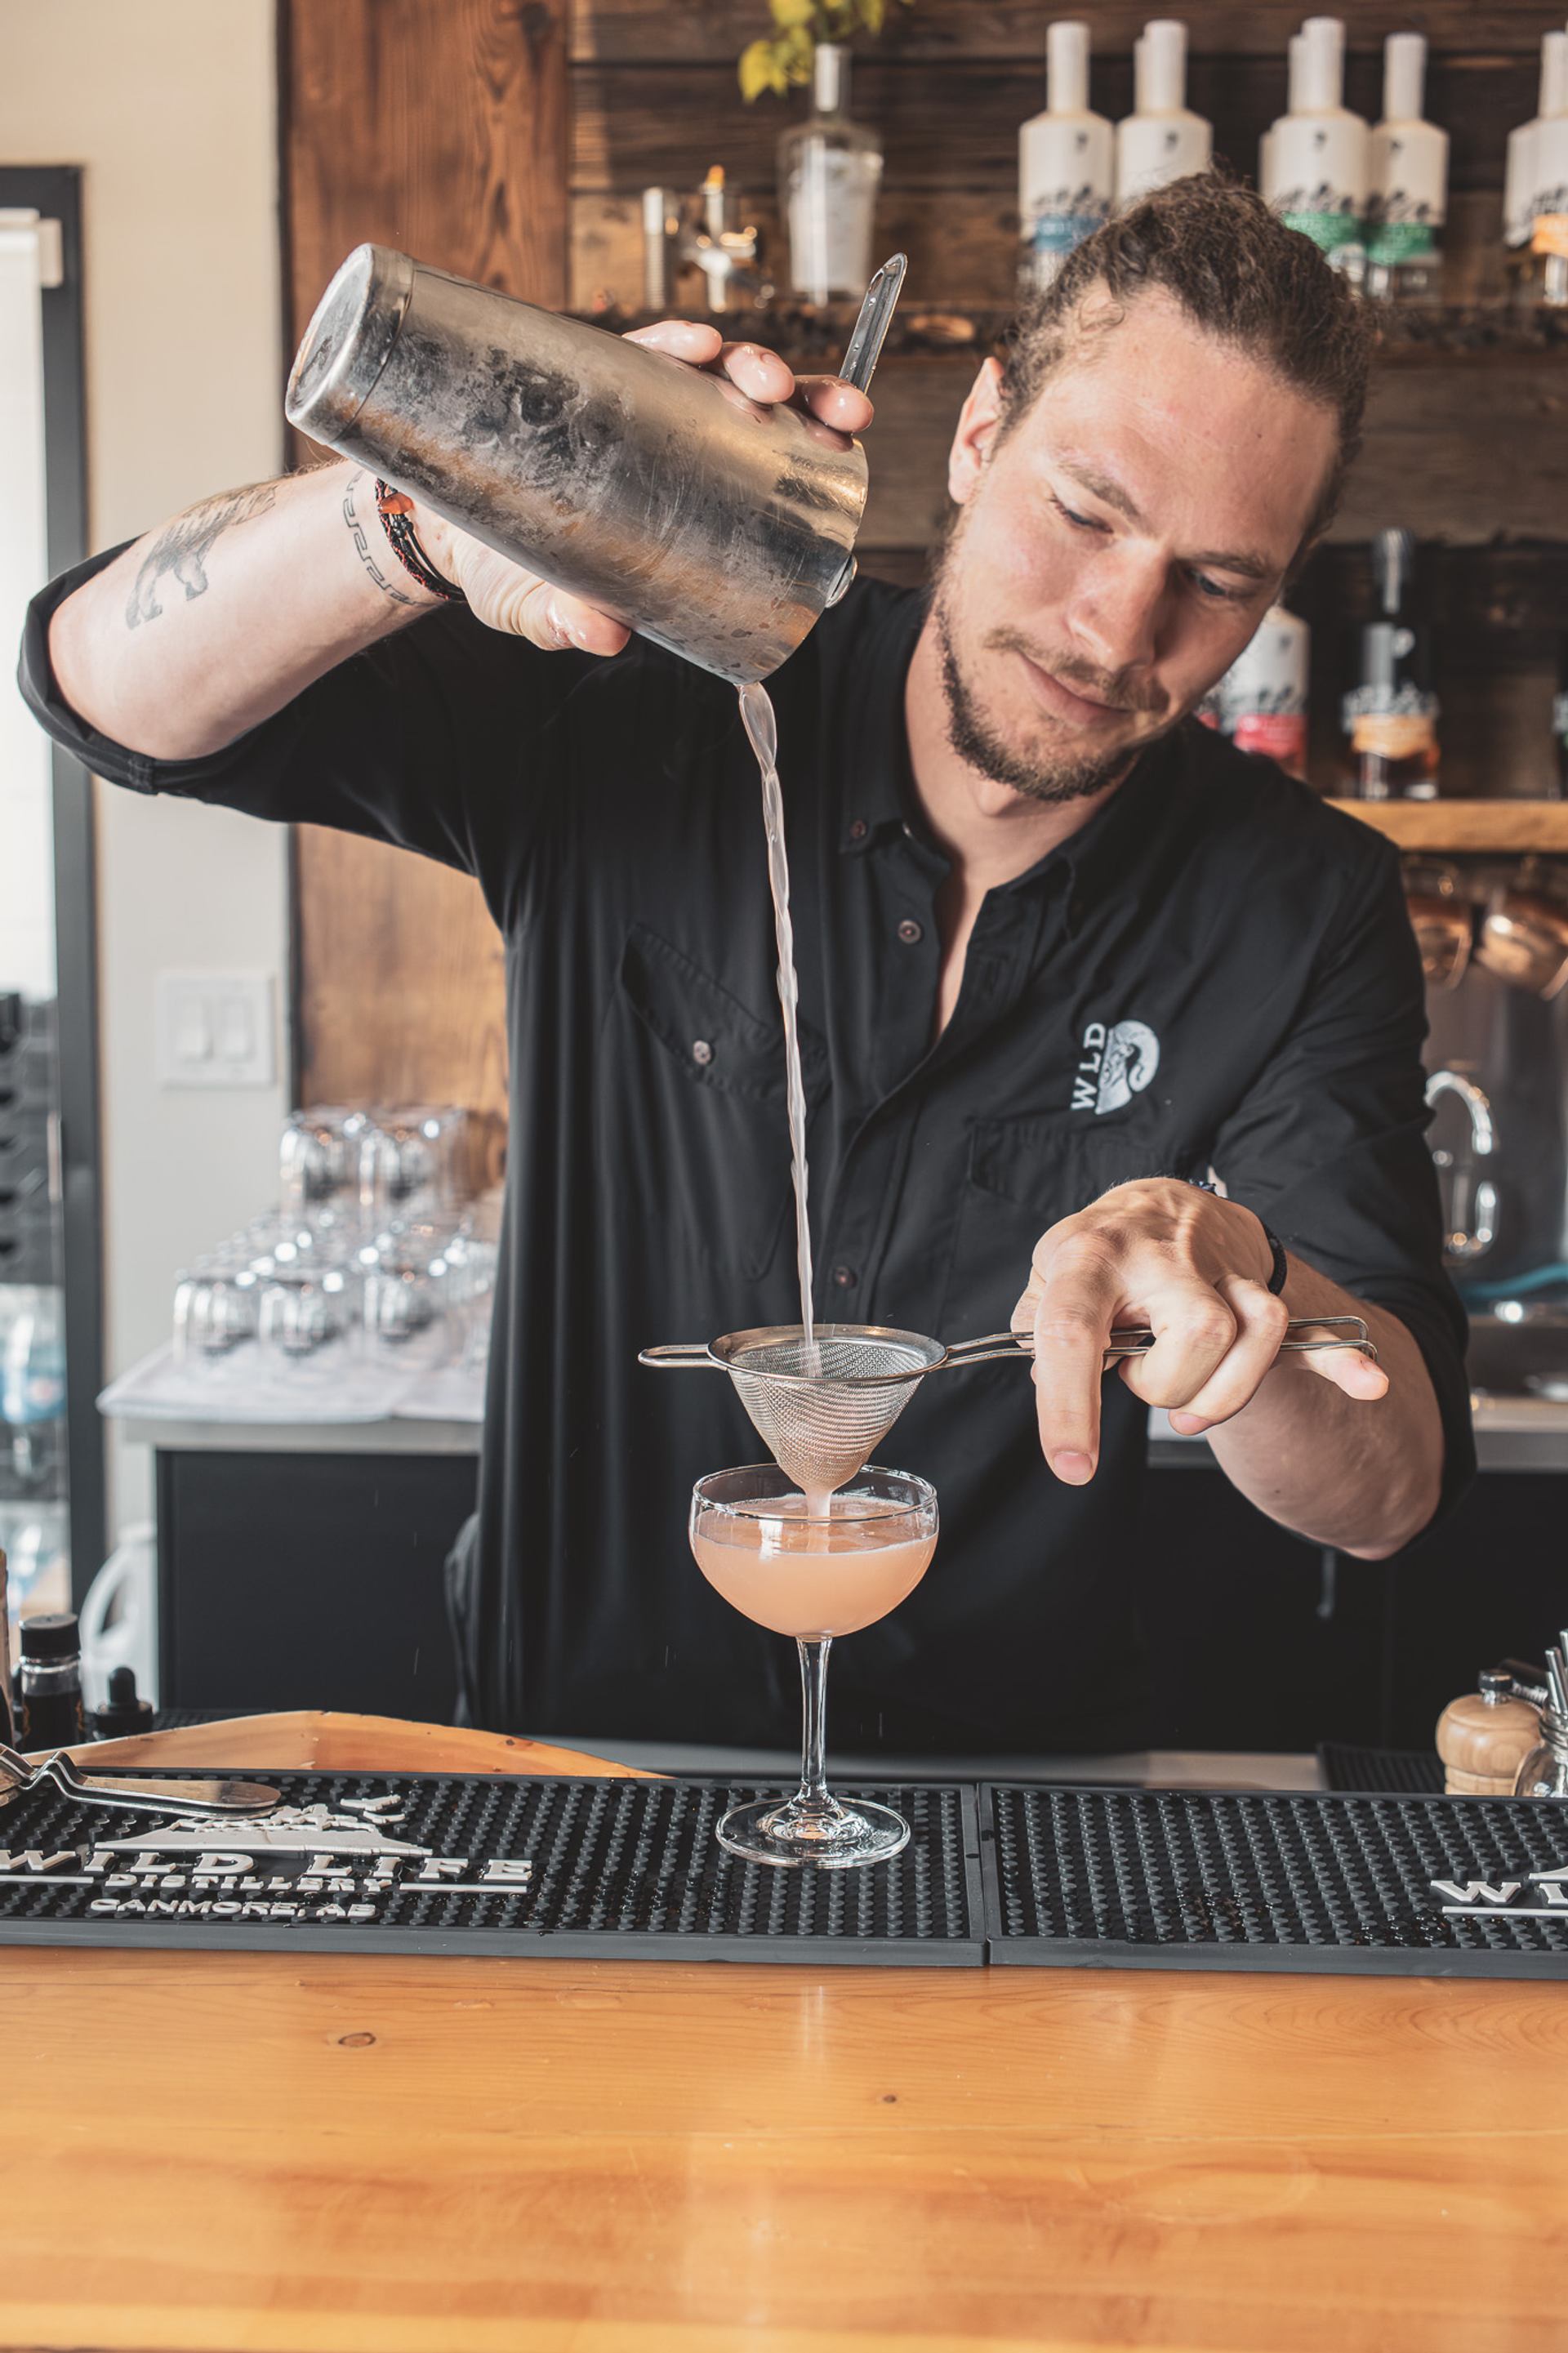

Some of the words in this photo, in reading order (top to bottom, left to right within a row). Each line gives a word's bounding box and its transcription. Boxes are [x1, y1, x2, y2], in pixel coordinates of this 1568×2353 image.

[1070, 1023, 1106, 1110] WLD
[0, 1850, 254, 1874] WILD
[303, 1854, 532, 1880] LIFE
[105, 1874, 393, 1892] DISTILLERY
[90, 1898, 305, 1917] CANMORE,
[315, 1903, 376, 1917] AB
